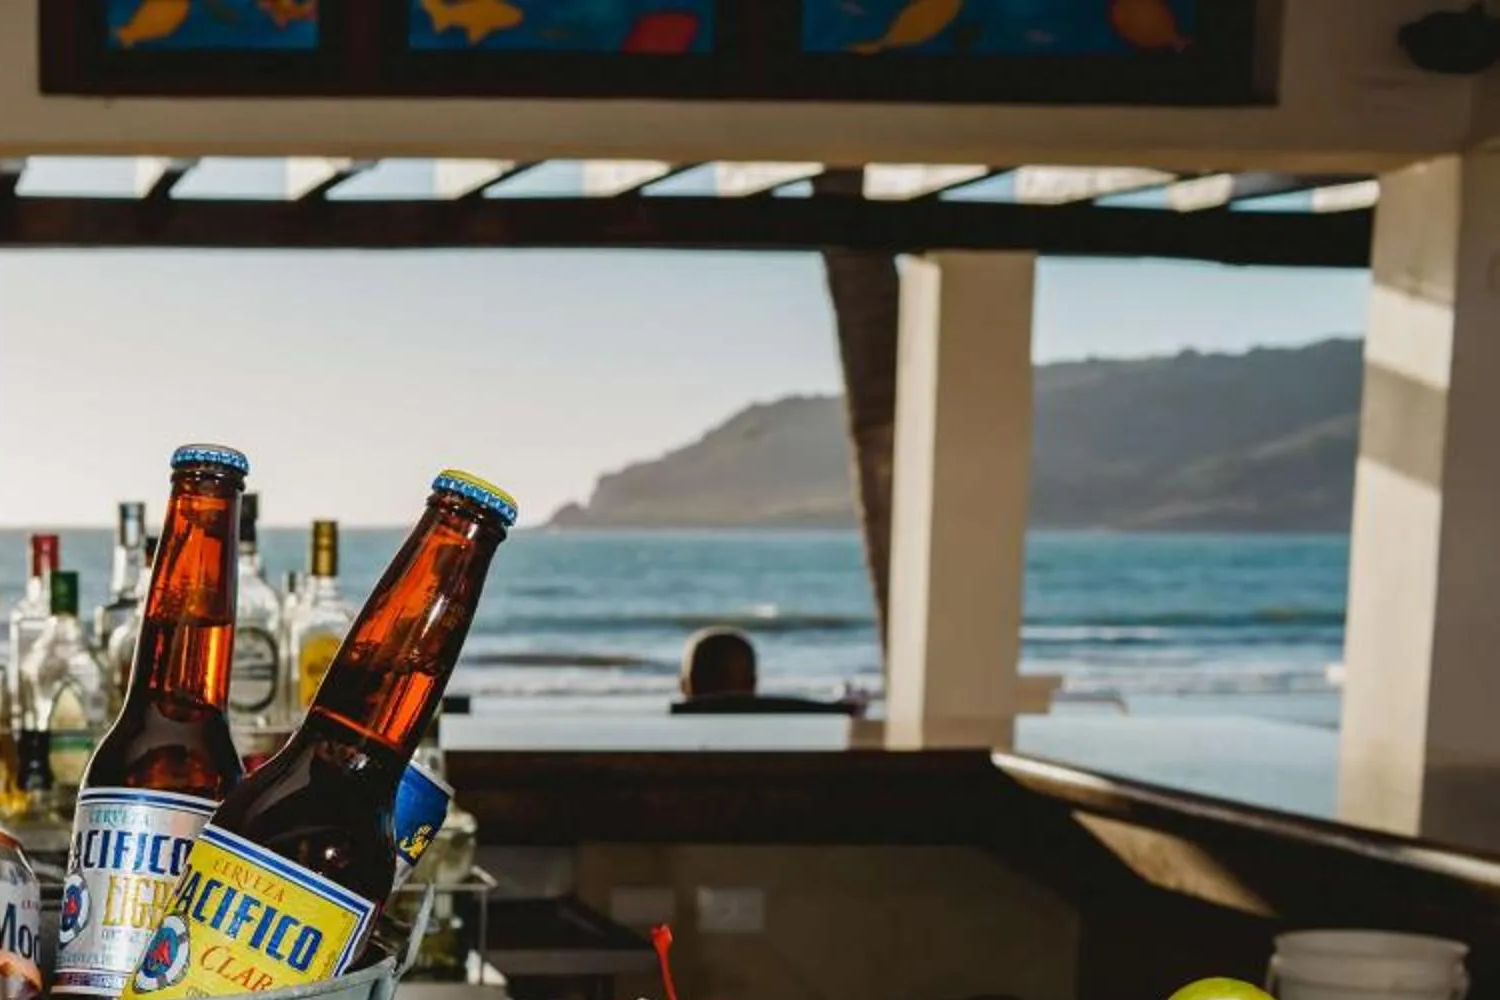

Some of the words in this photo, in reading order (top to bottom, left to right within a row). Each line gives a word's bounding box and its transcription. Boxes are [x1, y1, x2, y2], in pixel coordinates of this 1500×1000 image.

[73, 829, 193, 875] ACIFICO
[102, 874, 176, 930] LIGH
[213, 858, 286, 903] CERVEZA
[175, 864, 323, 971] ACIFICO
[201, 945, 273, 991] CLAR
